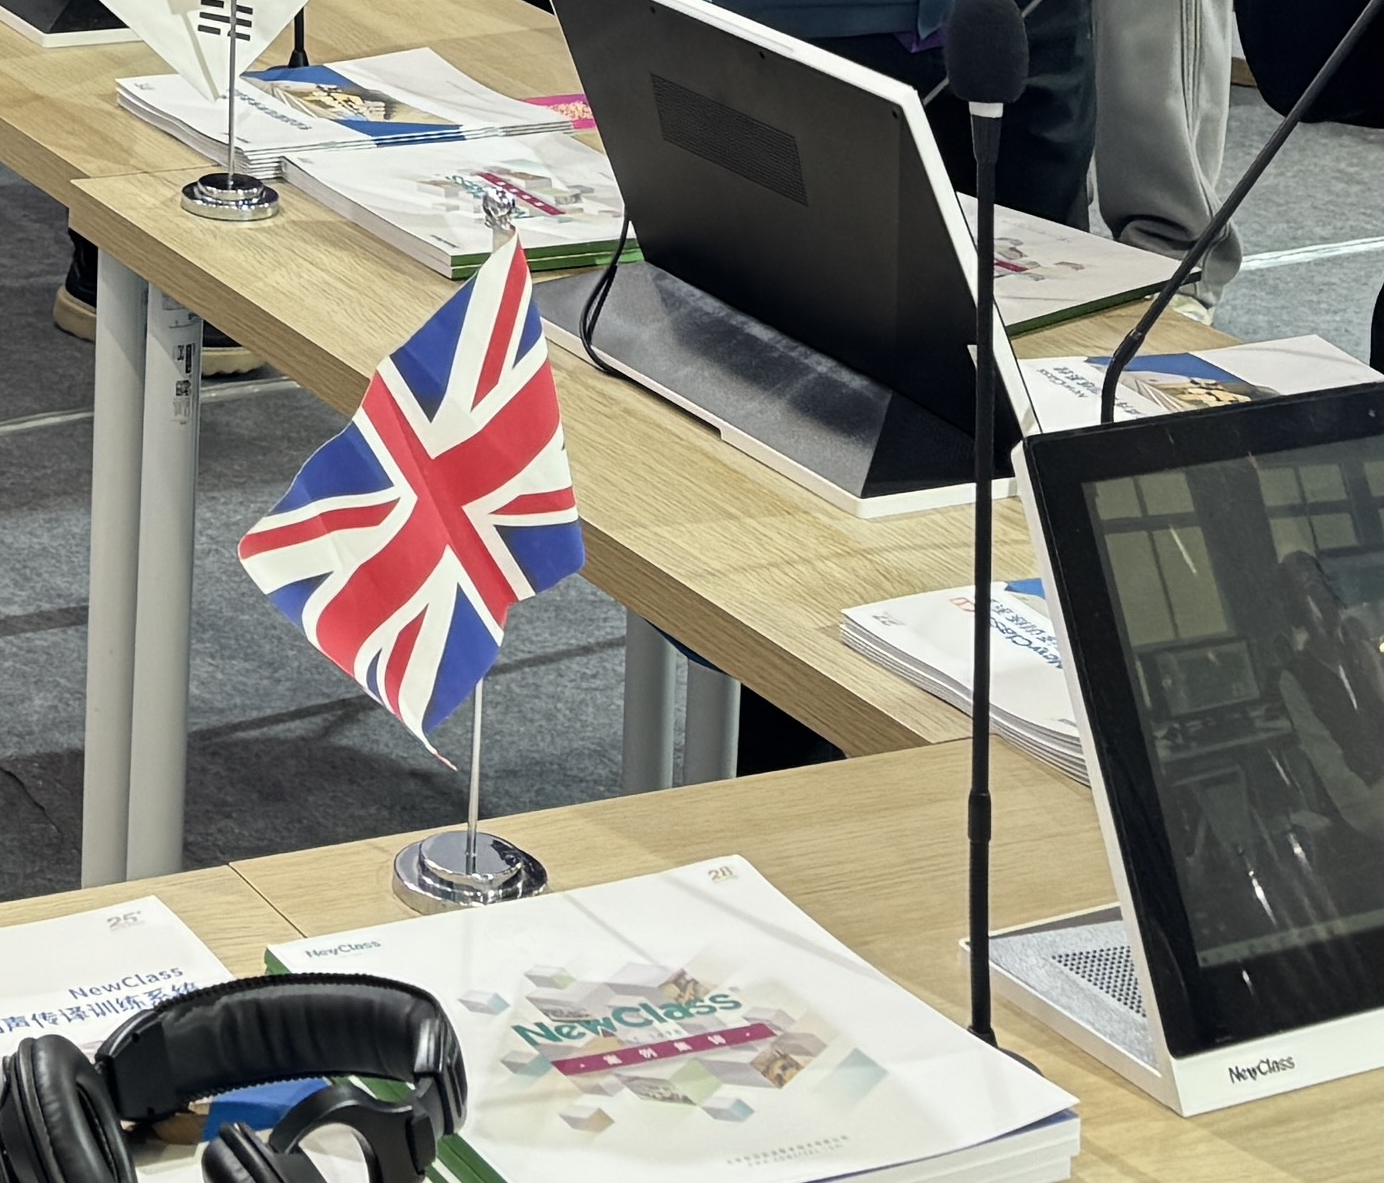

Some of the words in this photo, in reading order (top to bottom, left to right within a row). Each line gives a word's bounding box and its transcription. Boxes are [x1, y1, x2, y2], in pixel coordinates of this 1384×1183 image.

[68, 967, 184, 1000] NewClass
[511, 992, 743, 1049] NewClass
[1228, 1055, 1297, 1085] NewClass
